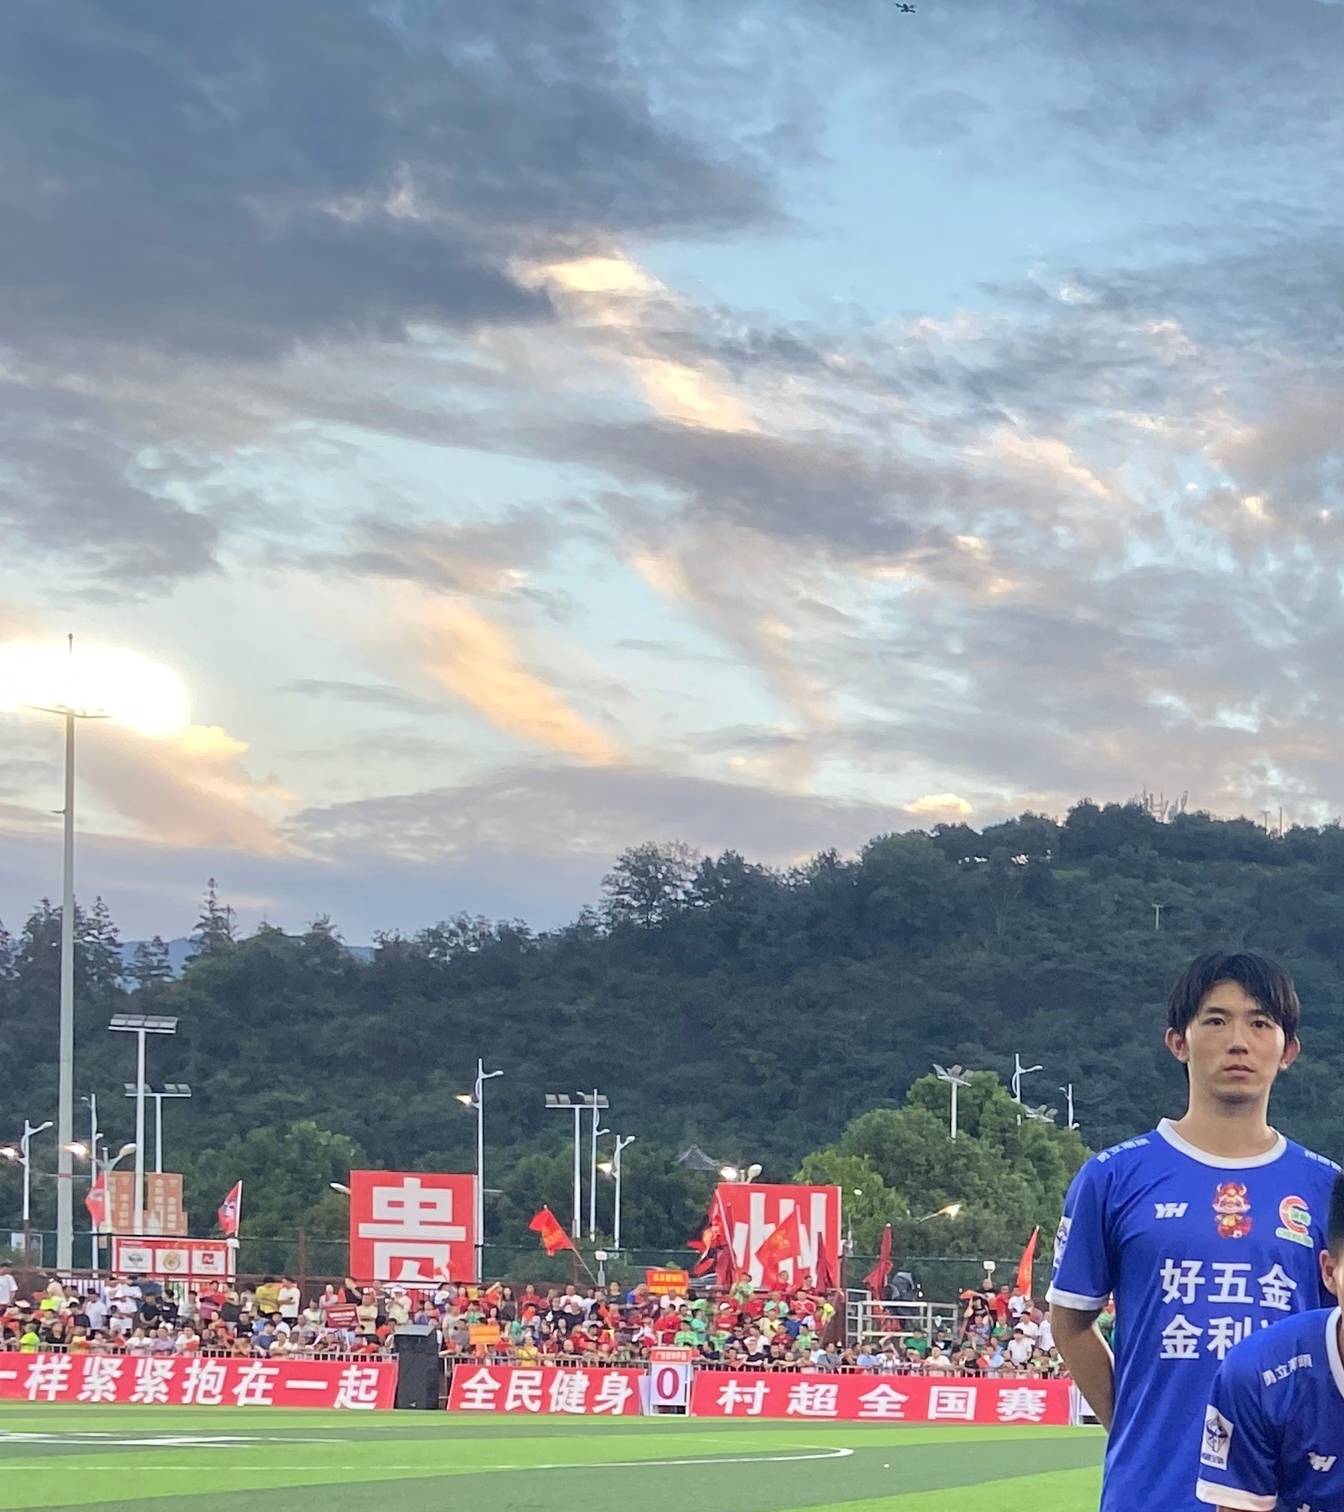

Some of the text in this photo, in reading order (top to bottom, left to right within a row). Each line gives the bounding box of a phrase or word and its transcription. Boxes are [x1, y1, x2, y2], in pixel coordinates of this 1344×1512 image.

[358, 1178, 466, 1282] 贵
[1160, 1258, 1297, 1311] 好五金
[1160, 1315, 1270, 1360] 金利
[460, 1367, 634, 1415] 全民健身
[656, 1367, 679, 1401] 0
[717, 1379, 1048, 1423] 村超全国赛
